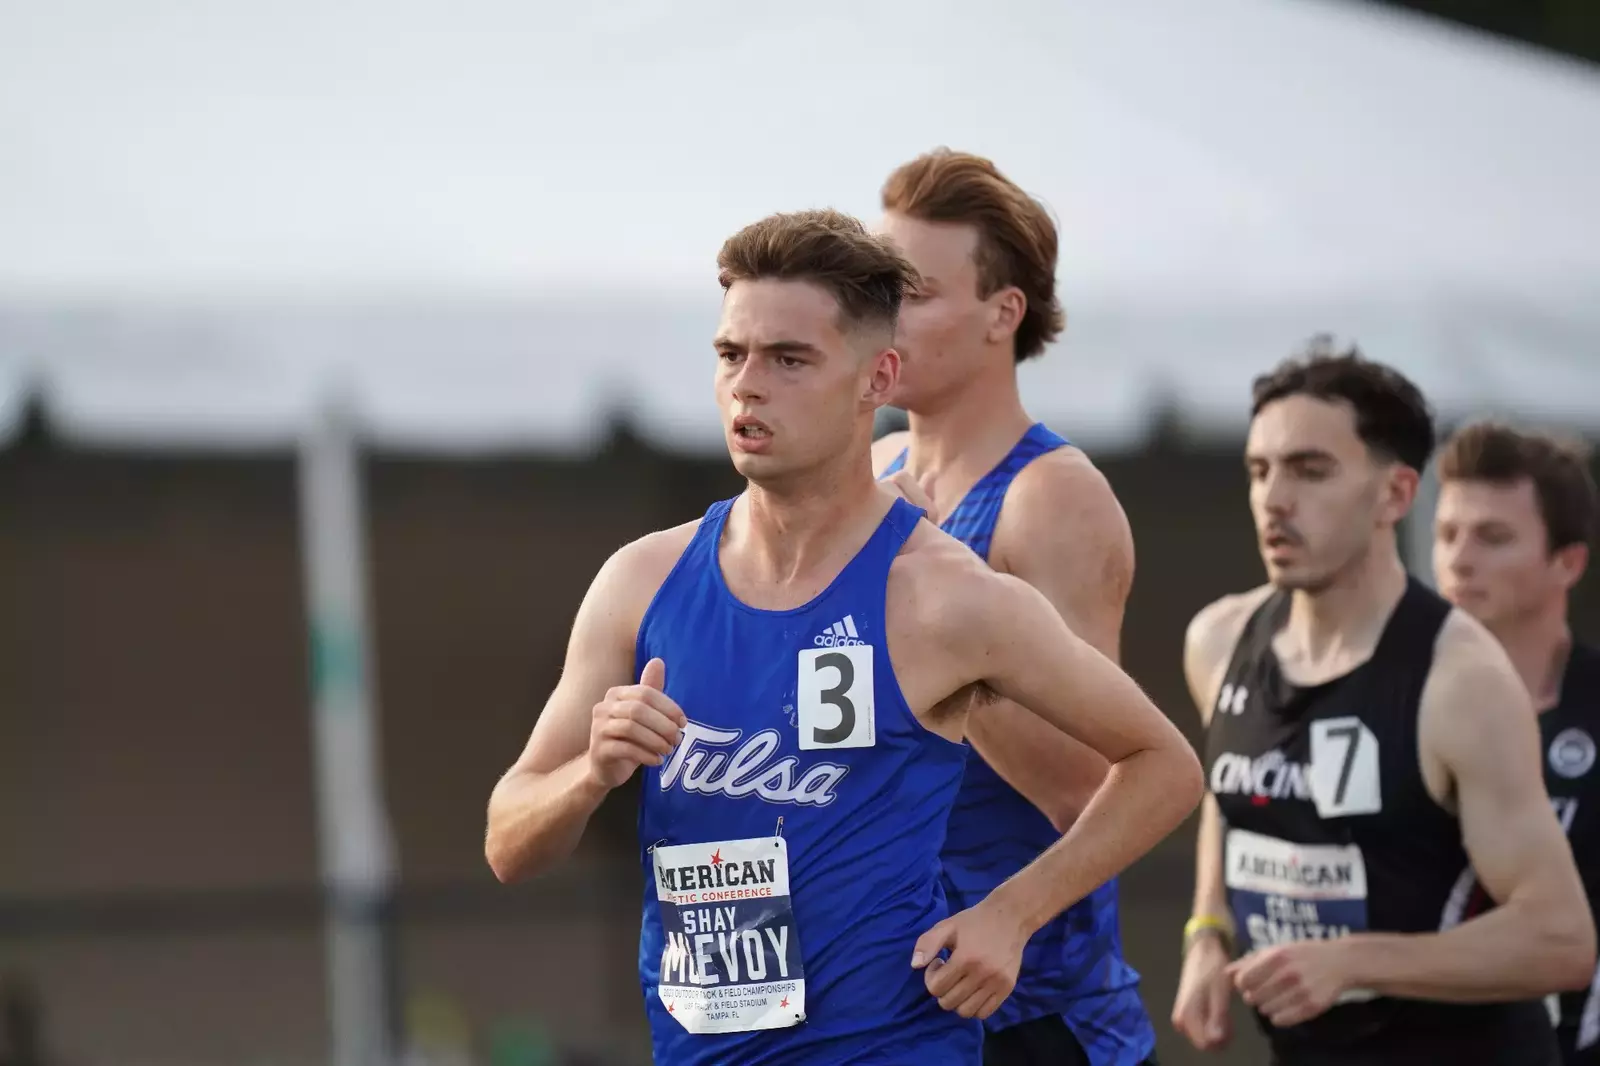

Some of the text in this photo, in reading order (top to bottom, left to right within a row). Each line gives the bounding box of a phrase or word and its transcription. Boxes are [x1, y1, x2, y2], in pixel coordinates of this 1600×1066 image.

[813, 652, 856, 744] 3
[660, 719, 850, 807] Tulsa
[1326, 726, 1361, 806] 7
[702, 887, 772, 902] CONFERENCE
[683, 906, 736, 934] SHAY
[718, 989, 723, 998] &
[724, 988, 742, 997] FIELD
[742, 982, 796, 996] CHAMPIONSHIPS
[714, 1001, 720, 1010] &
[721, 1000, 739, 1009] FIELD
[739, 998, 768, 1008] STADIUM
[732, 1011, 740, 1019] FL
